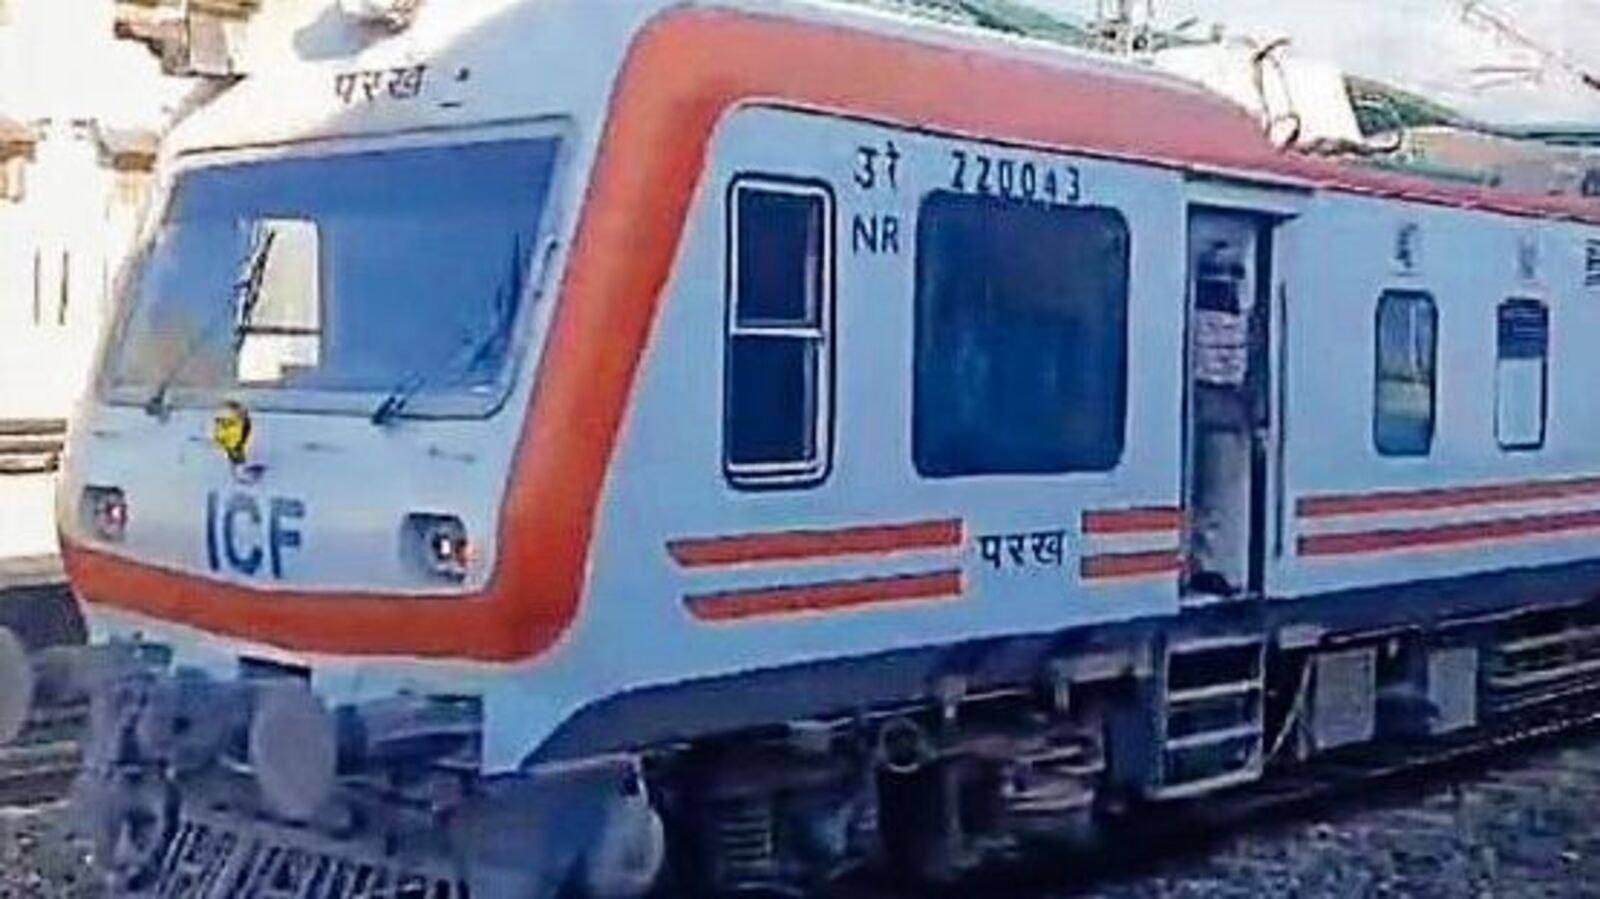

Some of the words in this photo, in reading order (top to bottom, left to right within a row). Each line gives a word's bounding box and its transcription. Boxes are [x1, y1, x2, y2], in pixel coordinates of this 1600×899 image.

[852, 213, 899, 254] NR
[206, 491, 306, 579] ICF
[978, 531, 1065, 569] परख
